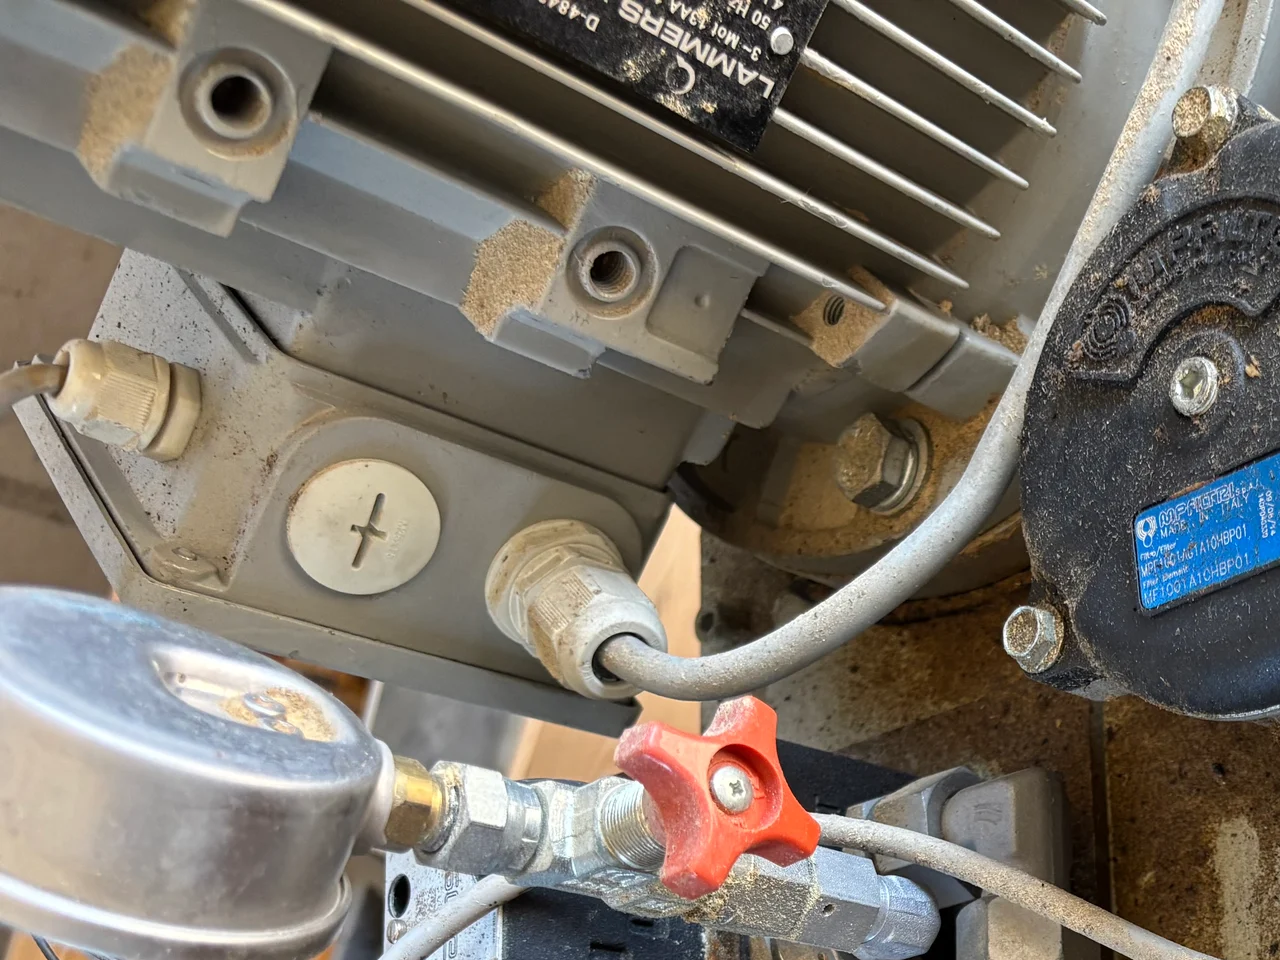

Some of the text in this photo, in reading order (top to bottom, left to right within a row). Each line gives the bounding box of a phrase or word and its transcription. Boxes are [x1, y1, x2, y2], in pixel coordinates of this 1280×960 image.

[751, 10, 772, 31] 50
[618, 0, 775, 99] LAMMERS
[710, 21, 740, 50] Mot
